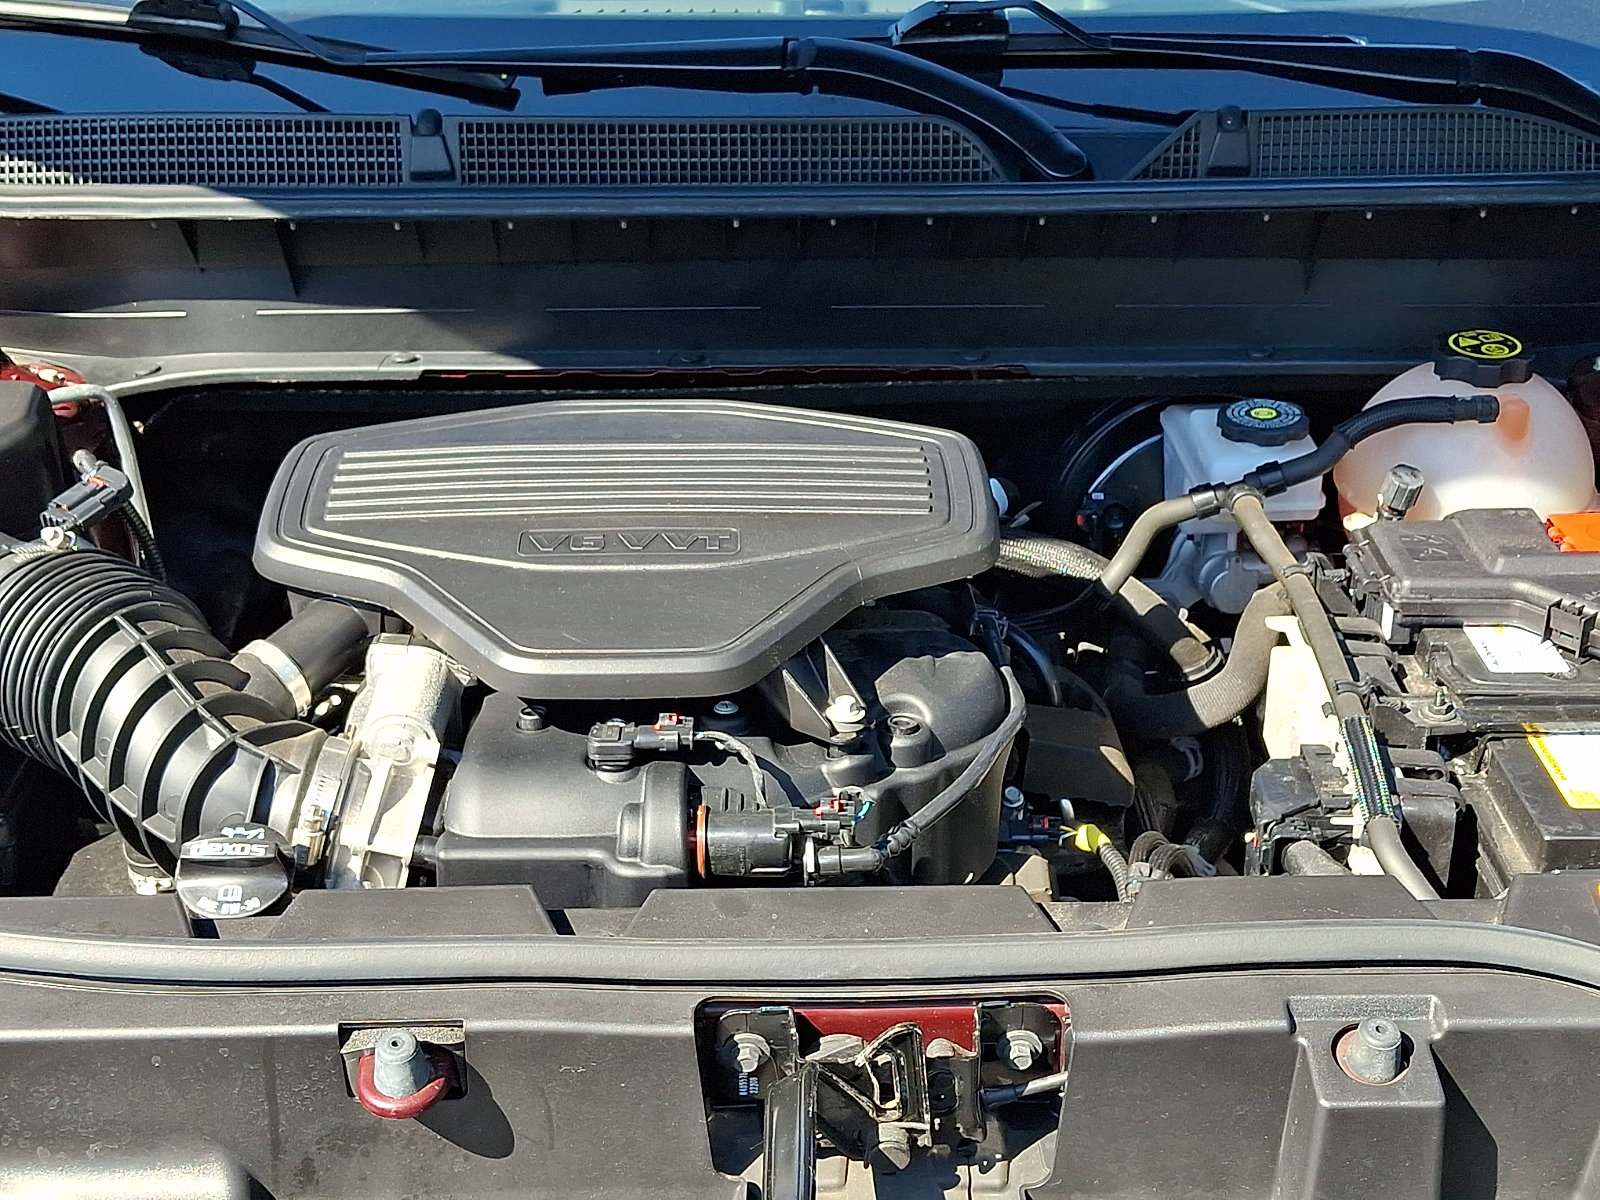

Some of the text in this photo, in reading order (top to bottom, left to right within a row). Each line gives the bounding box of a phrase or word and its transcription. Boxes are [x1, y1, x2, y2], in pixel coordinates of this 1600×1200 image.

[528, 532, 731, 551] V6 VVT
[189, 841, 270, 857] dexos
